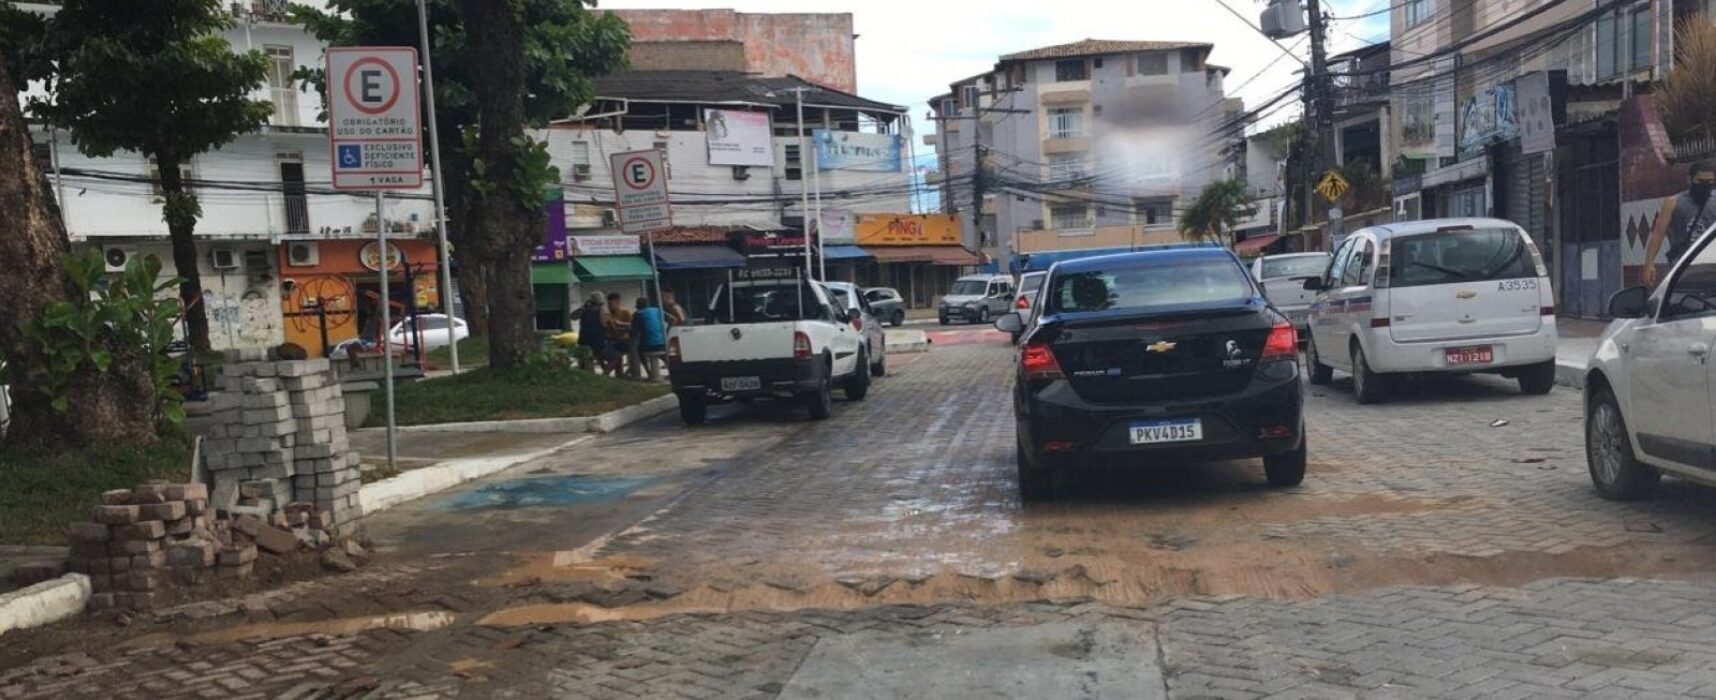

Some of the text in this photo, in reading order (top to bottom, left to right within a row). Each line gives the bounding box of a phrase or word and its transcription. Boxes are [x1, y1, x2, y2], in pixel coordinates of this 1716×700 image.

[361, 70, 382, 102] E
[343, 117, 405, 126] OBRIGATÓRIO
[337, 126, 413, 135] USO DO CARTÃO
[364, 152, 414, 160] DEFICIENTE
[632, 164, 646, 183] E
[378, 176, 404, 184] VAGA
[1498, 279, 1537, 292] A3535
[1136, 424, 1195, 442] PKV4D15
